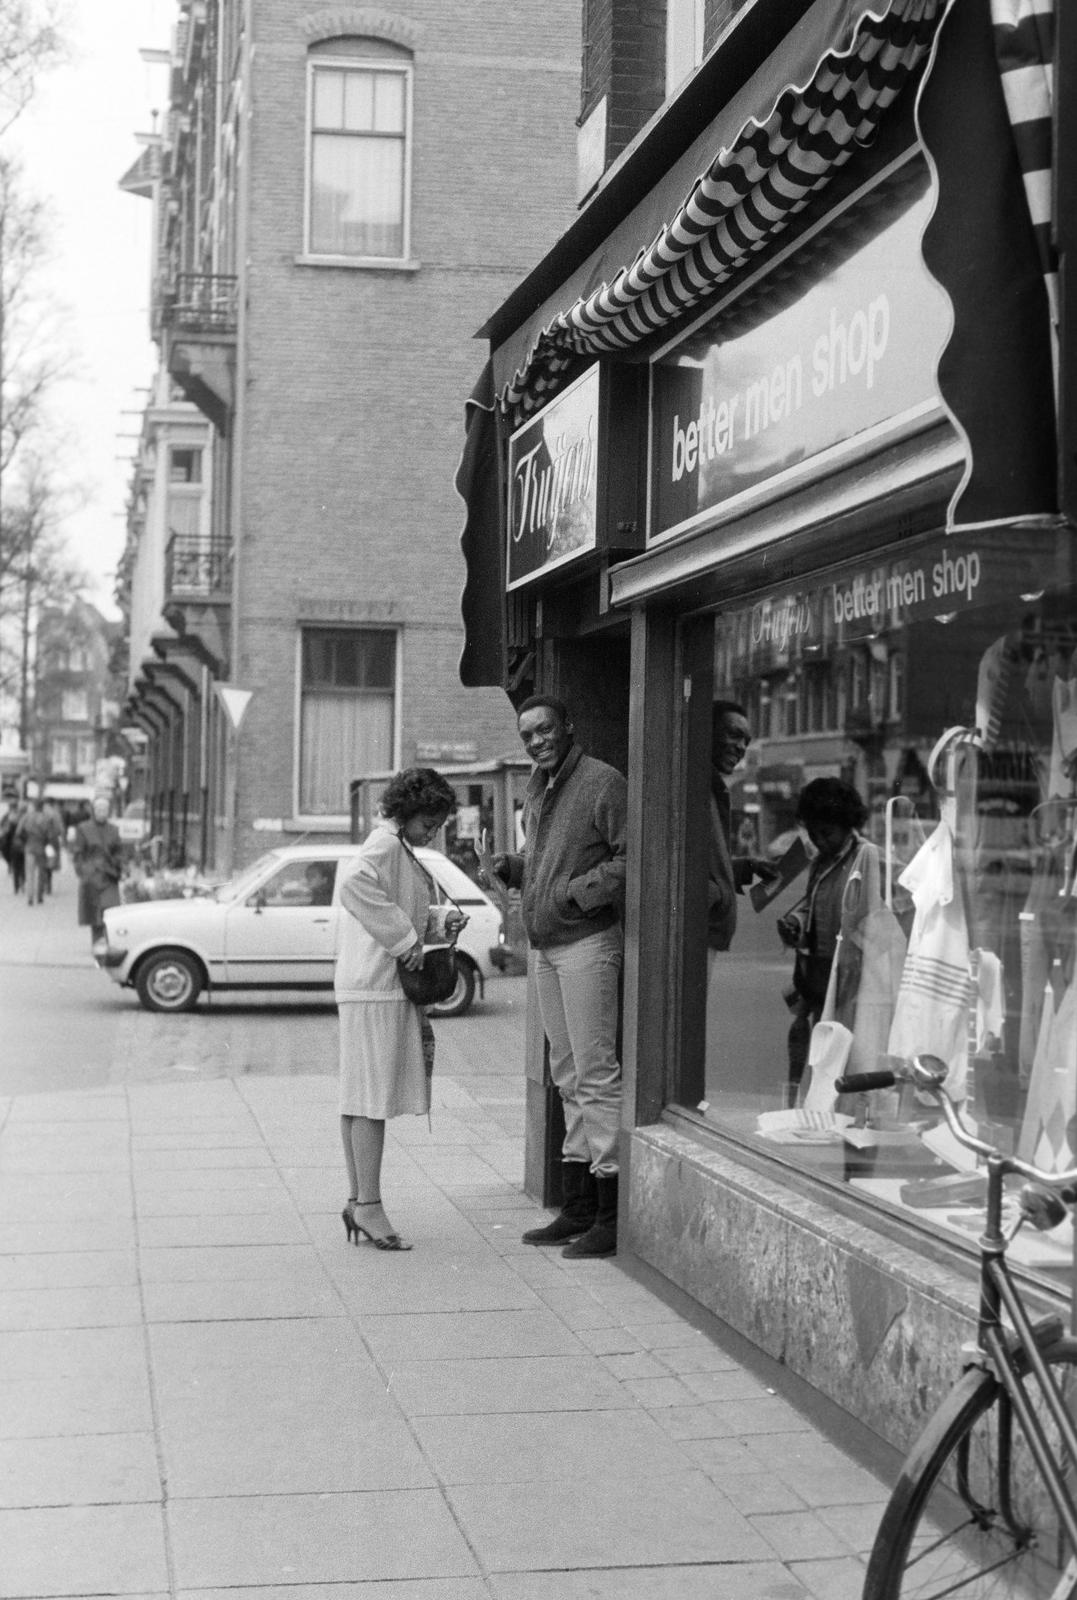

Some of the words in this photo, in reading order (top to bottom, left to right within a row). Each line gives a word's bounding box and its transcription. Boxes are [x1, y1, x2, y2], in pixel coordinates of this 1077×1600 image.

[672, 393, 740, 482] better
[744, 353, 802, 441] men
[811, 292, 890, 398] shop
[832, 573, 882, 624] better
[887, 567, 925, 610] men
[932, 548, 981, 602] shop
